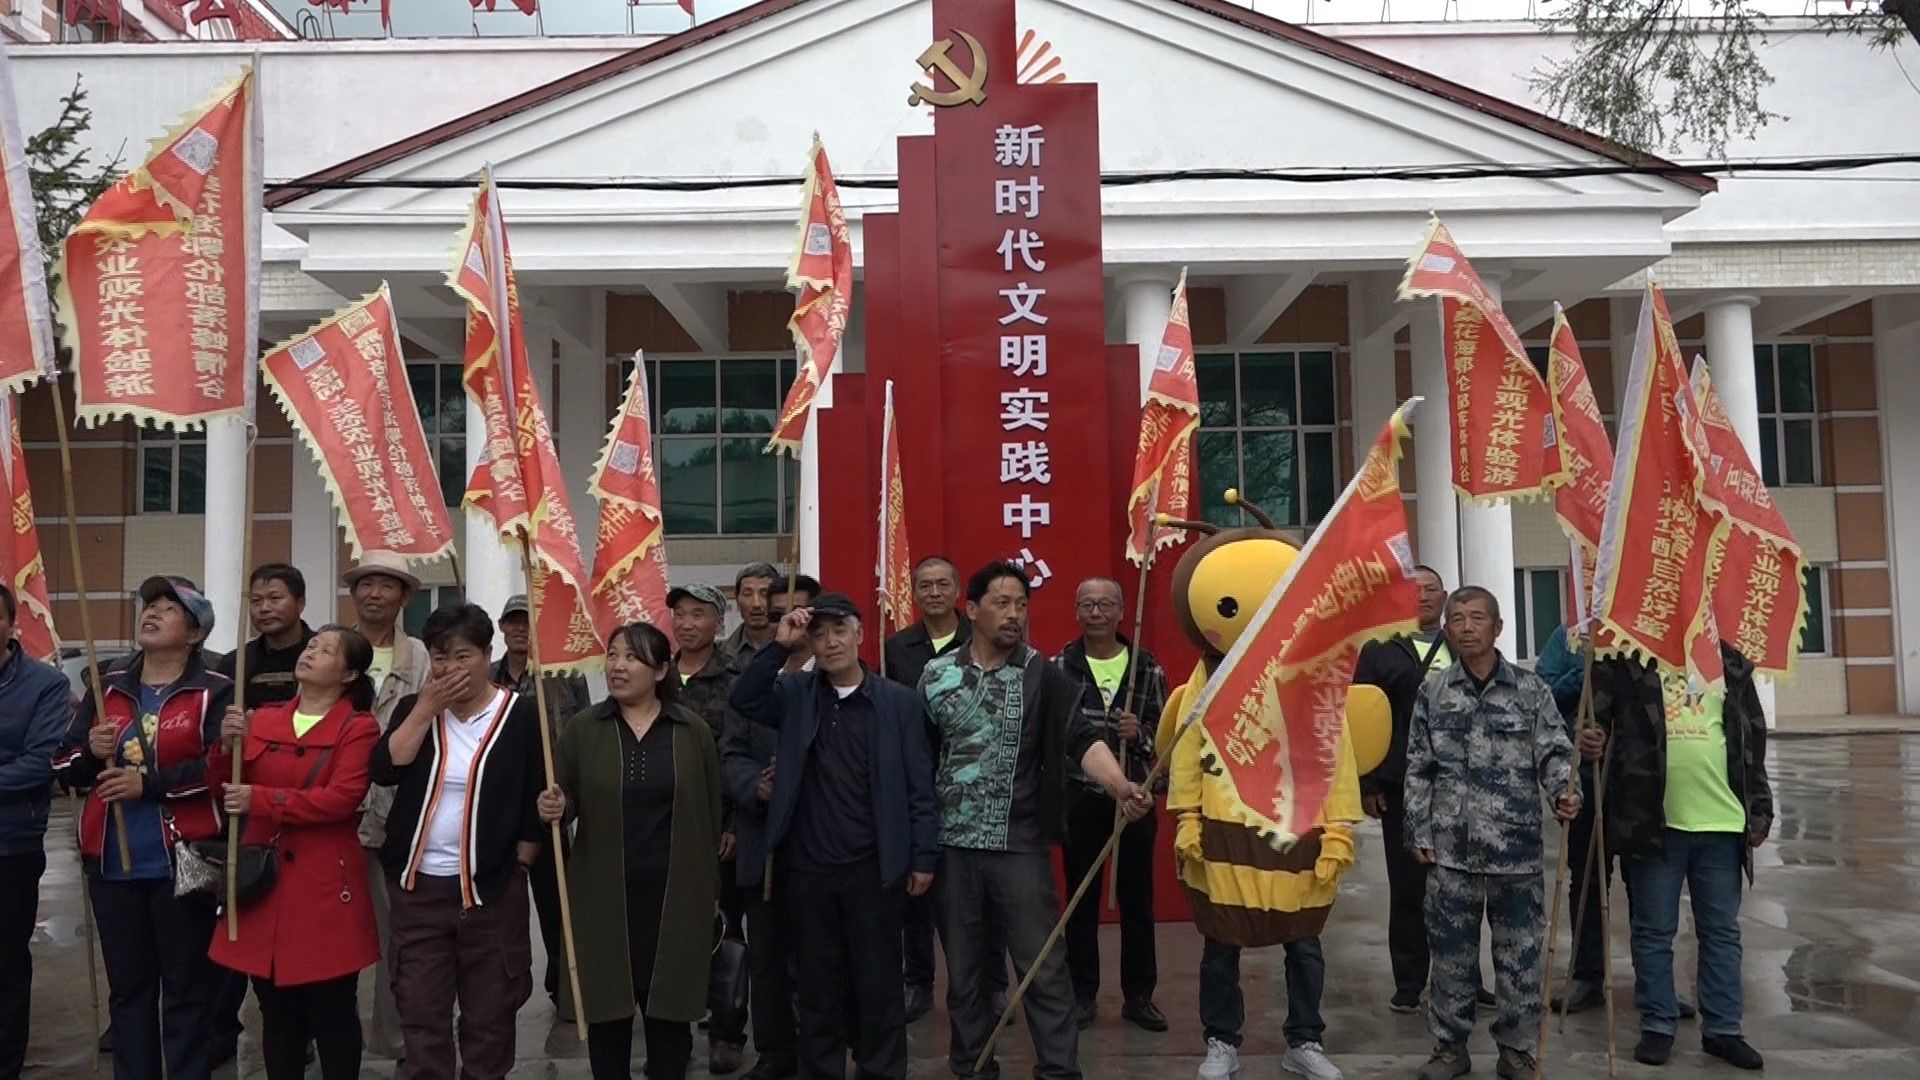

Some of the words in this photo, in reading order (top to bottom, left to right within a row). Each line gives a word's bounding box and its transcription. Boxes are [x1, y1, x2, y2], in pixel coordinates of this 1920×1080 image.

[994, 124, 1052, 588] 新时代文明实践中心
